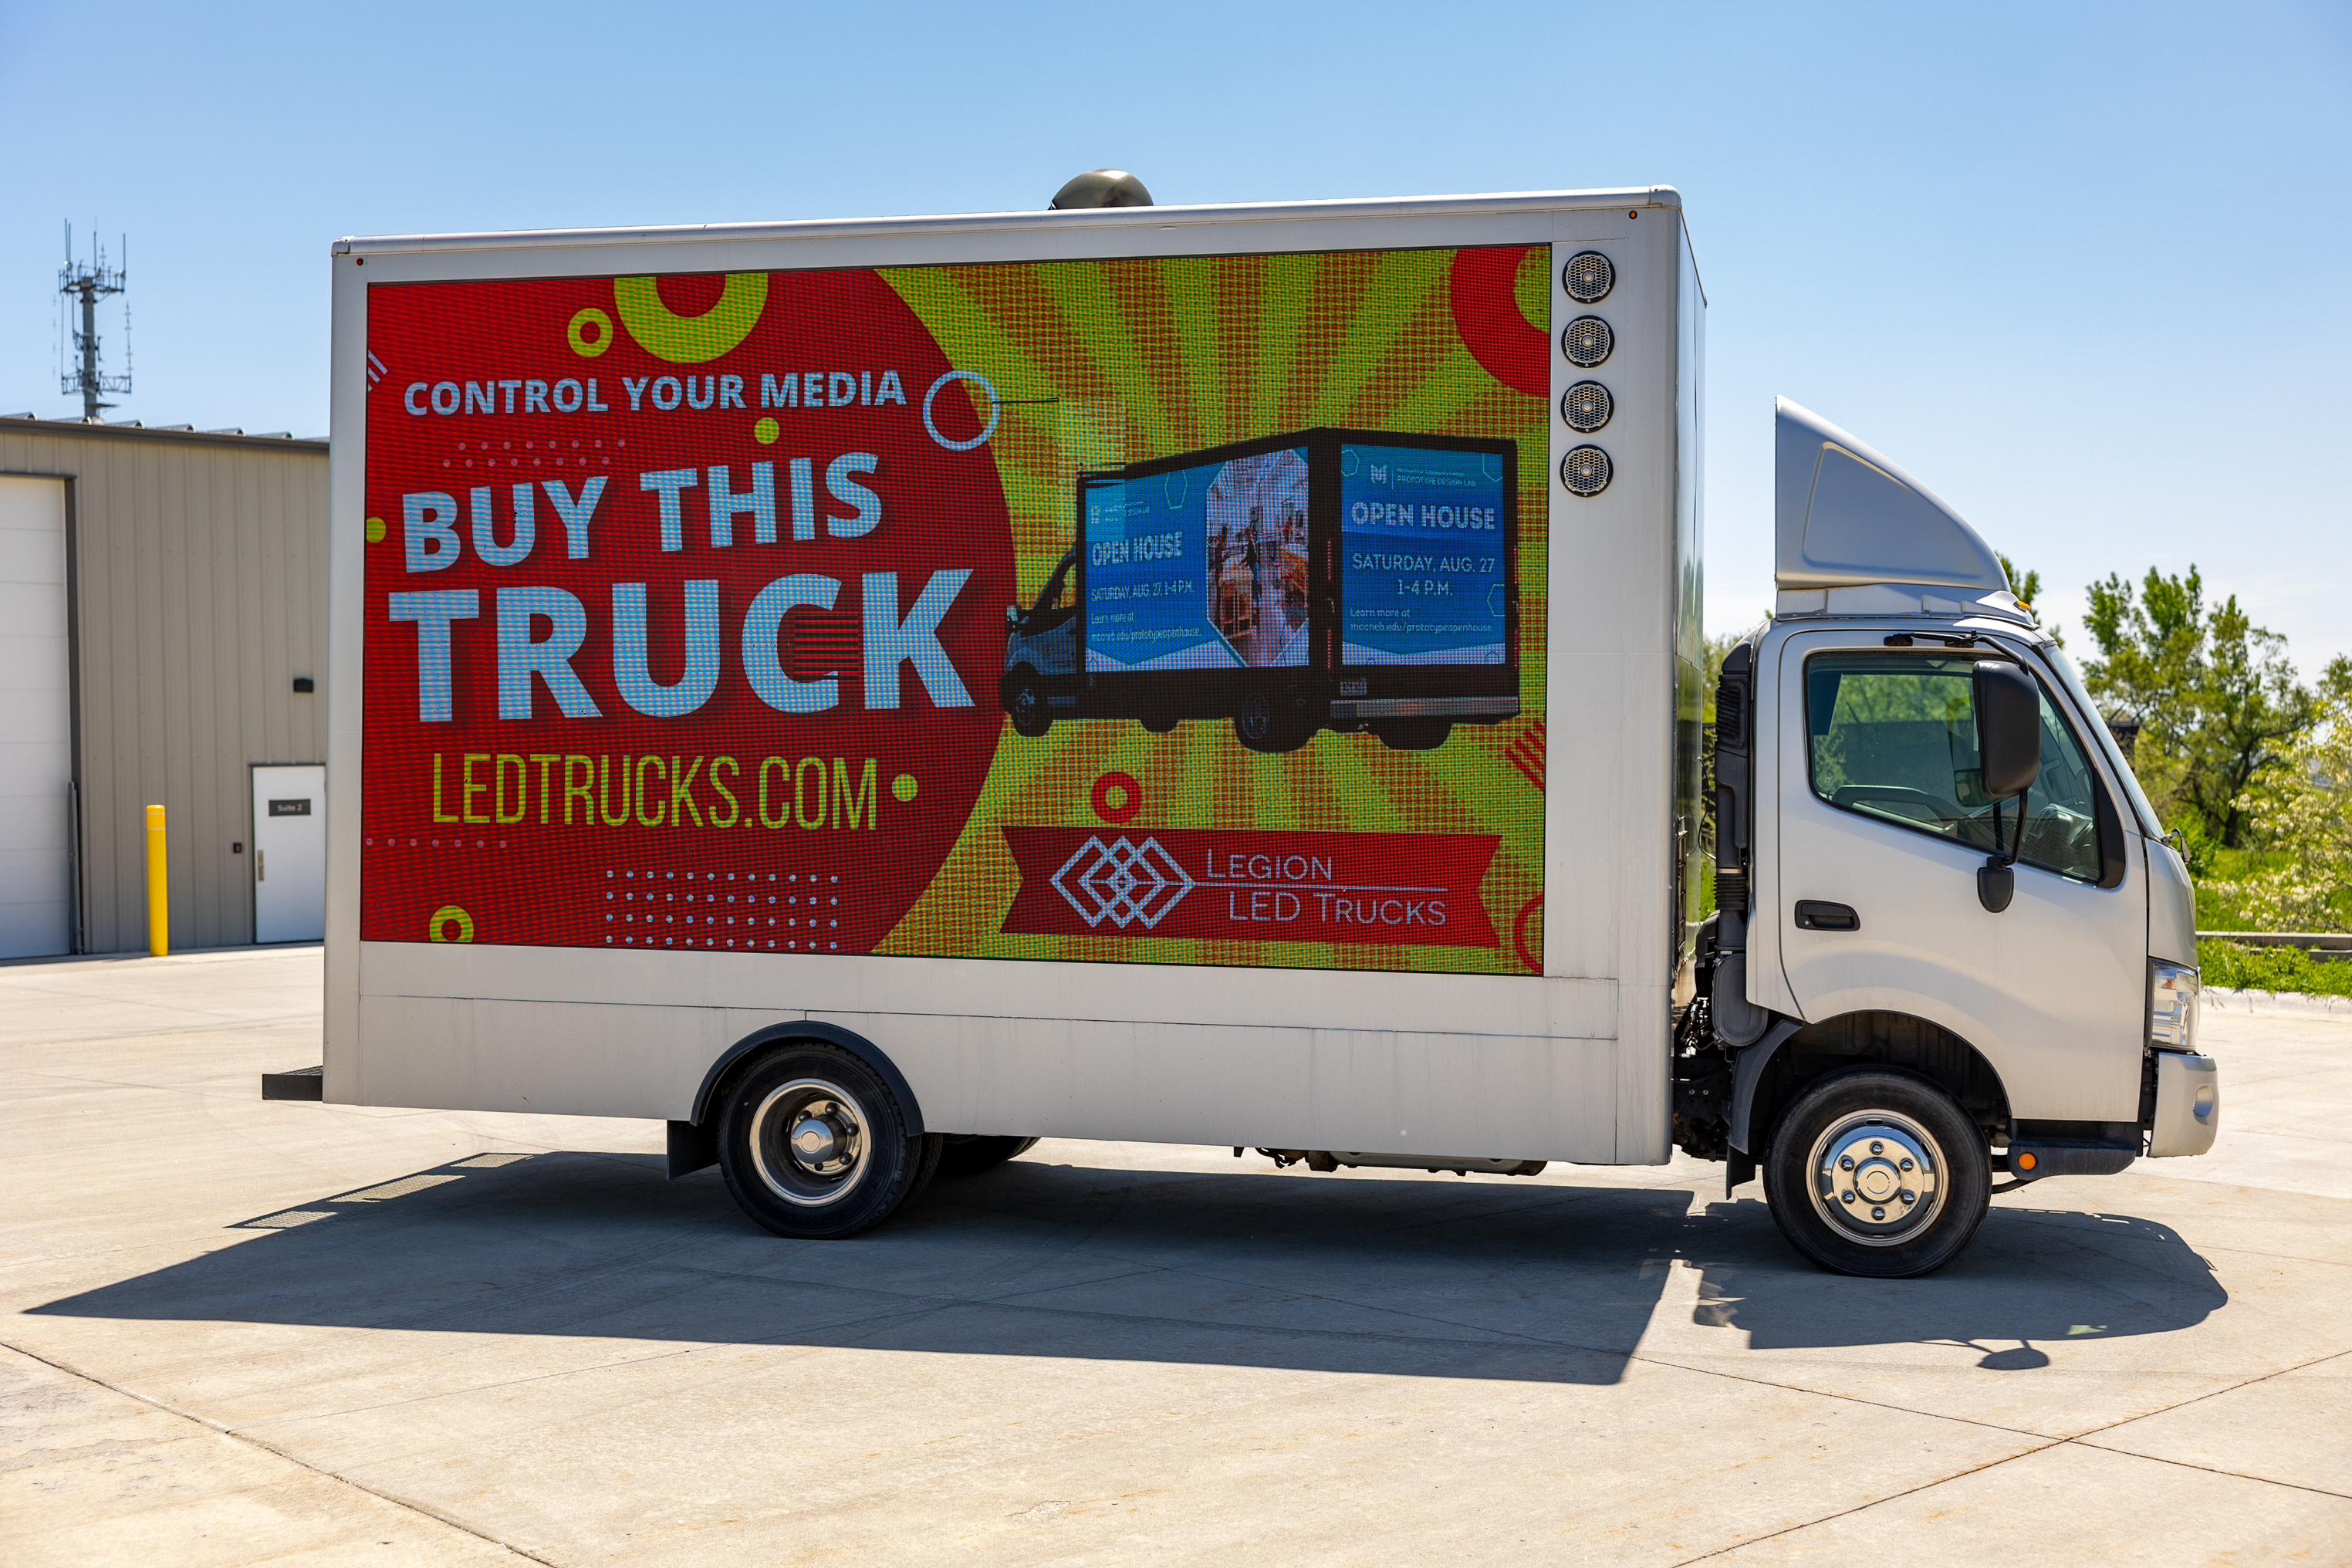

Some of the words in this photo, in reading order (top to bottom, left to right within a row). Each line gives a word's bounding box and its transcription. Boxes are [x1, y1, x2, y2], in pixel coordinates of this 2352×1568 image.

[404, 377, 608, 415] CONTROL
[622, 375, 745, 411] YOUR
[760, 370, 907, 408] MEDIA
[402, 475, 609, 574] BUY
[639, 451, 882, 551] THIS
[1351, 502, 1414, 526] OPEN
[1421, 505, 1495, 529] HOUSE
[1092, 539, 1129, 566] OPEN
[1134, 532, 1182, 562] HOUSE
[1353, 553, 1436, 573] SATURDAY,
[1439, 556, 1475, 573] AUG.
[1479, 558, 1495, 573] 27
[1091, 586, 1131, 602] SATURDAY,
[1133, 583, 1151, 599] AUG.
[1397, 580, 1420, 596] 1-4
[1424, 580, 1453, 596] P.M.
[1091, 613, 1110, 624] Learn
[1350, 607, 1375, 617] Learn
[1401, 608, 1411, 617] at
[388, 569, 975, 723] TRUCK
[433, 753, 877, 831] LEDTRUCKS.COM
[1207, 848, 1333, 880] LEGION
[1229, 890, 1300, 922] LED
[1313, 893, 1447, 926] TRUCKS
